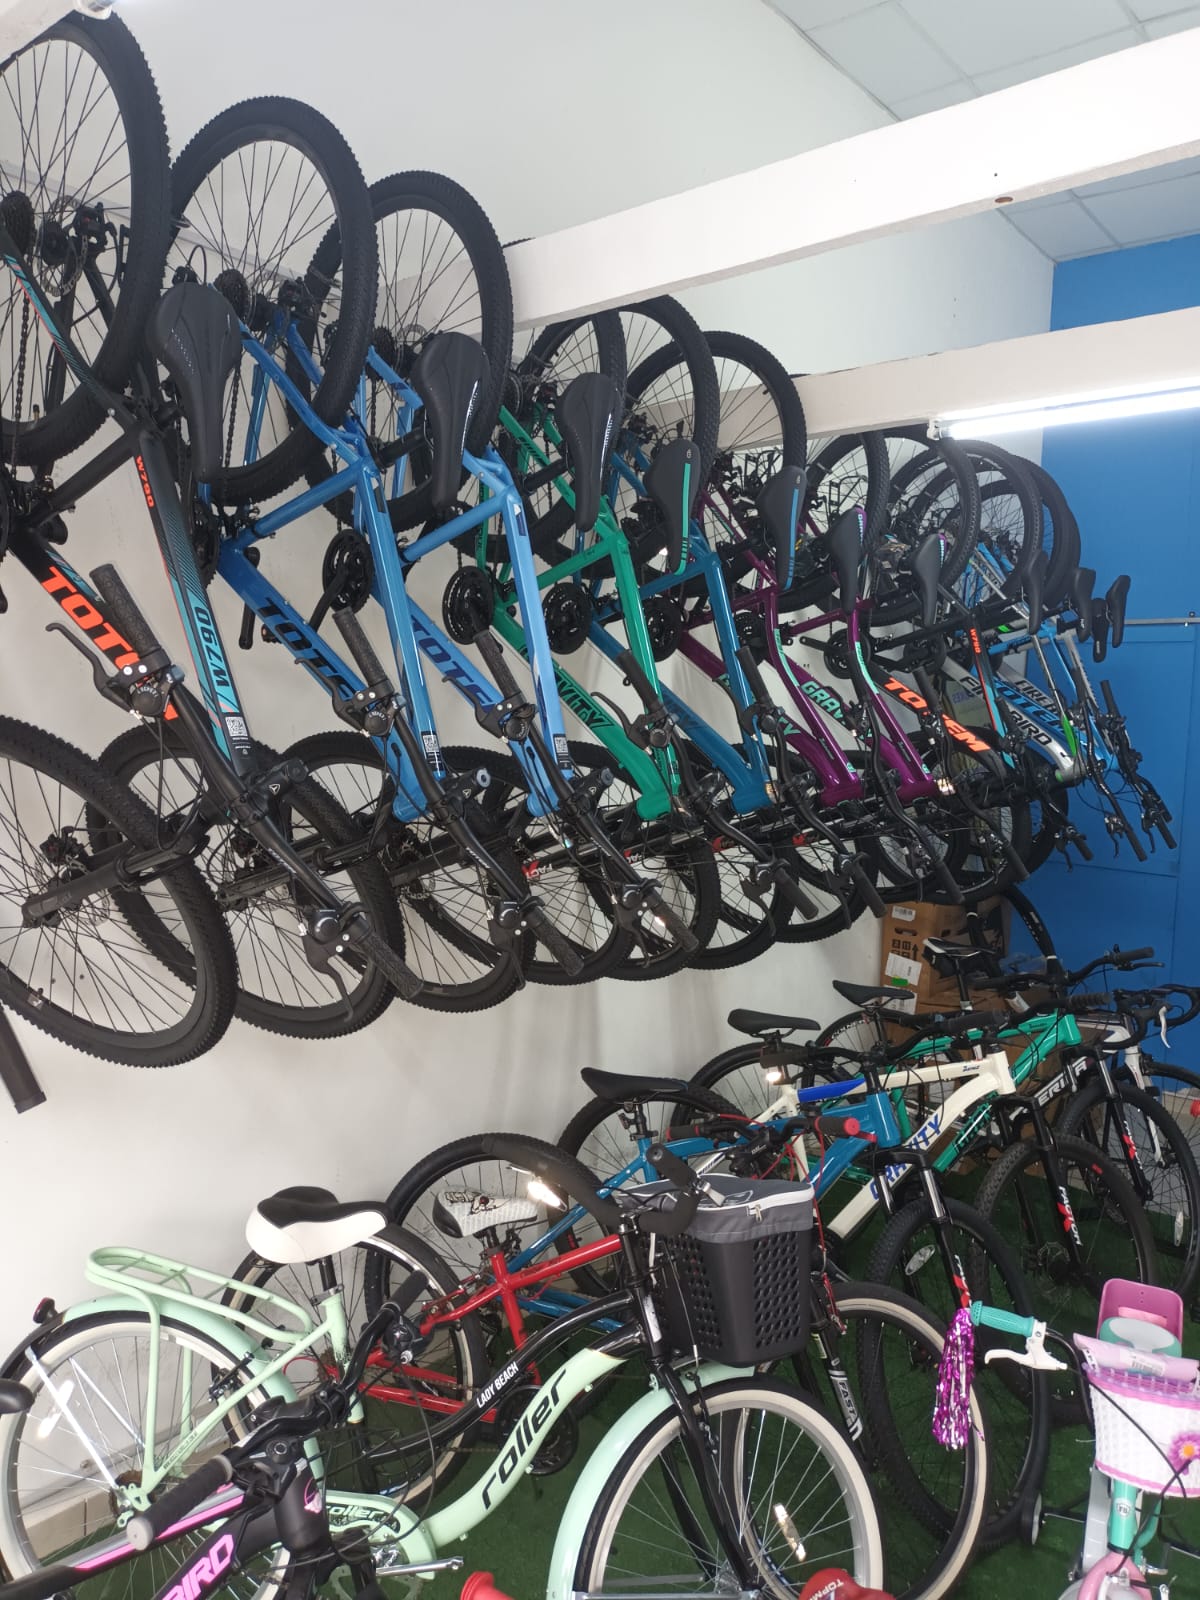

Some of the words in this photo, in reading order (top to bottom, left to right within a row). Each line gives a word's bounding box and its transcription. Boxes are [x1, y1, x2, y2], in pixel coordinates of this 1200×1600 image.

[136, 455, 155, 508] W790
[195, 606, 231, 688] W790
[257, 596, 362, 702] TOTE
[884, 676, 992, 753] TOEM
[476, 1387, 496, 1409] LADY
[494, 1361, 520, 1391] BEACH
[837, 1380, 858, 1416] FAST
[482, 1368, 567, 1510] roller
